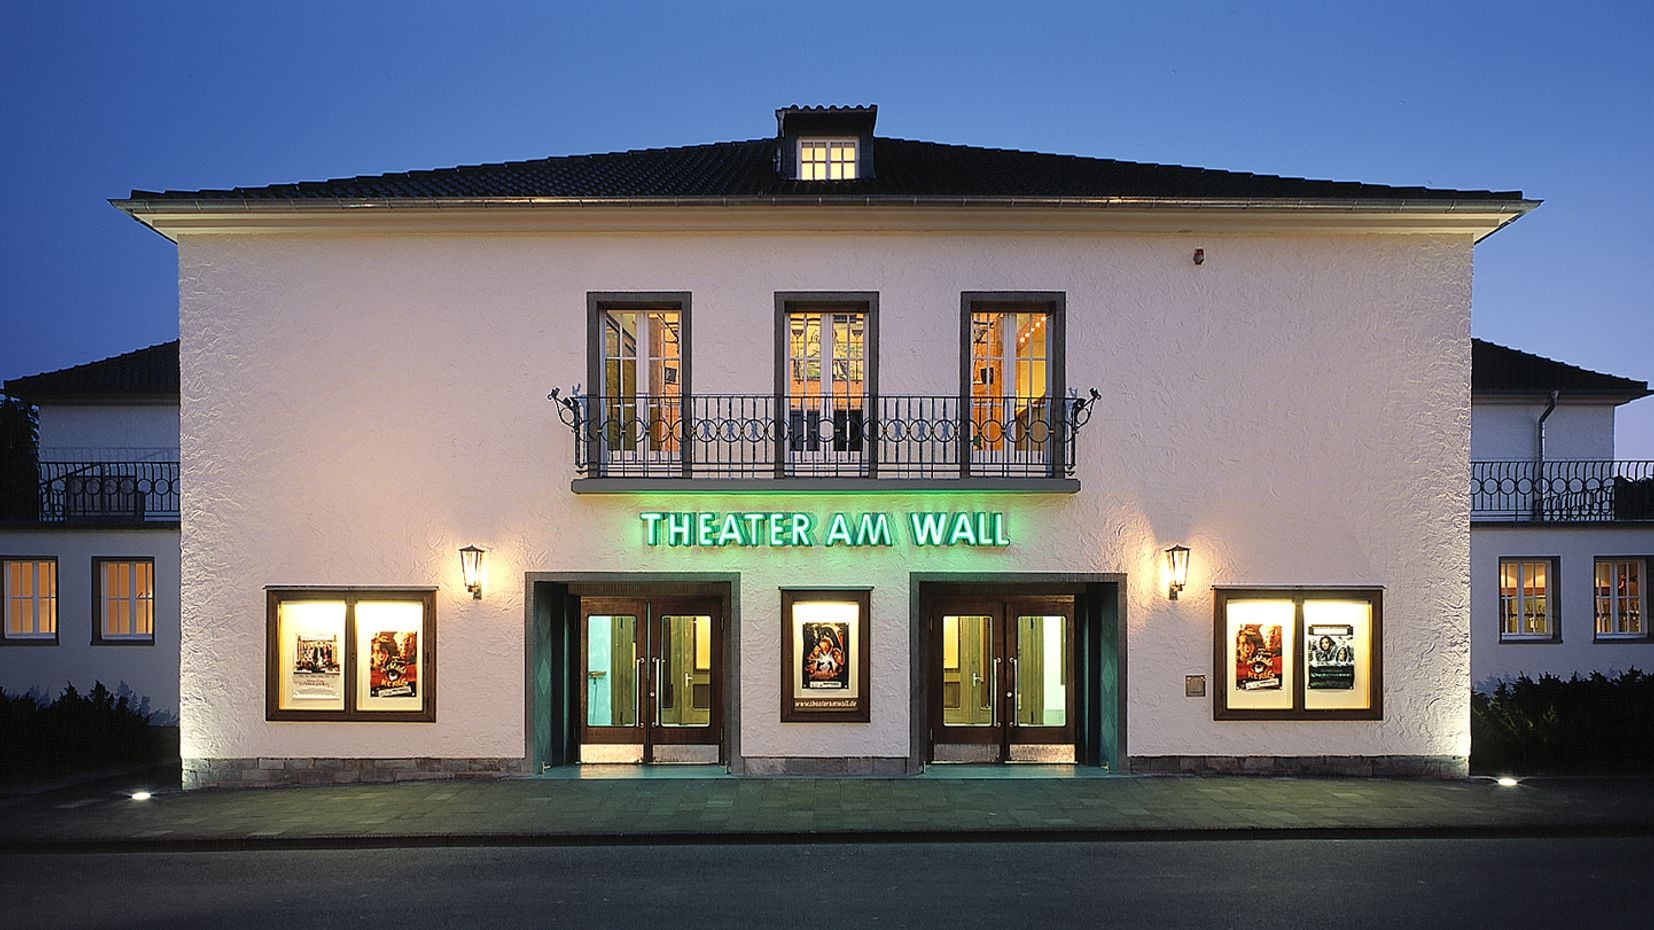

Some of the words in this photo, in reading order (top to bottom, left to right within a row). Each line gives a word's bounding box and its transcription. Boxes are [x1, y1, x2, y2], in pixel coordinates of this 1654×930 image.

[640, 512, 811, 546] THEATER
[827, 512, 892, 546] AM
[911, 512, 1010, 547] WALL
